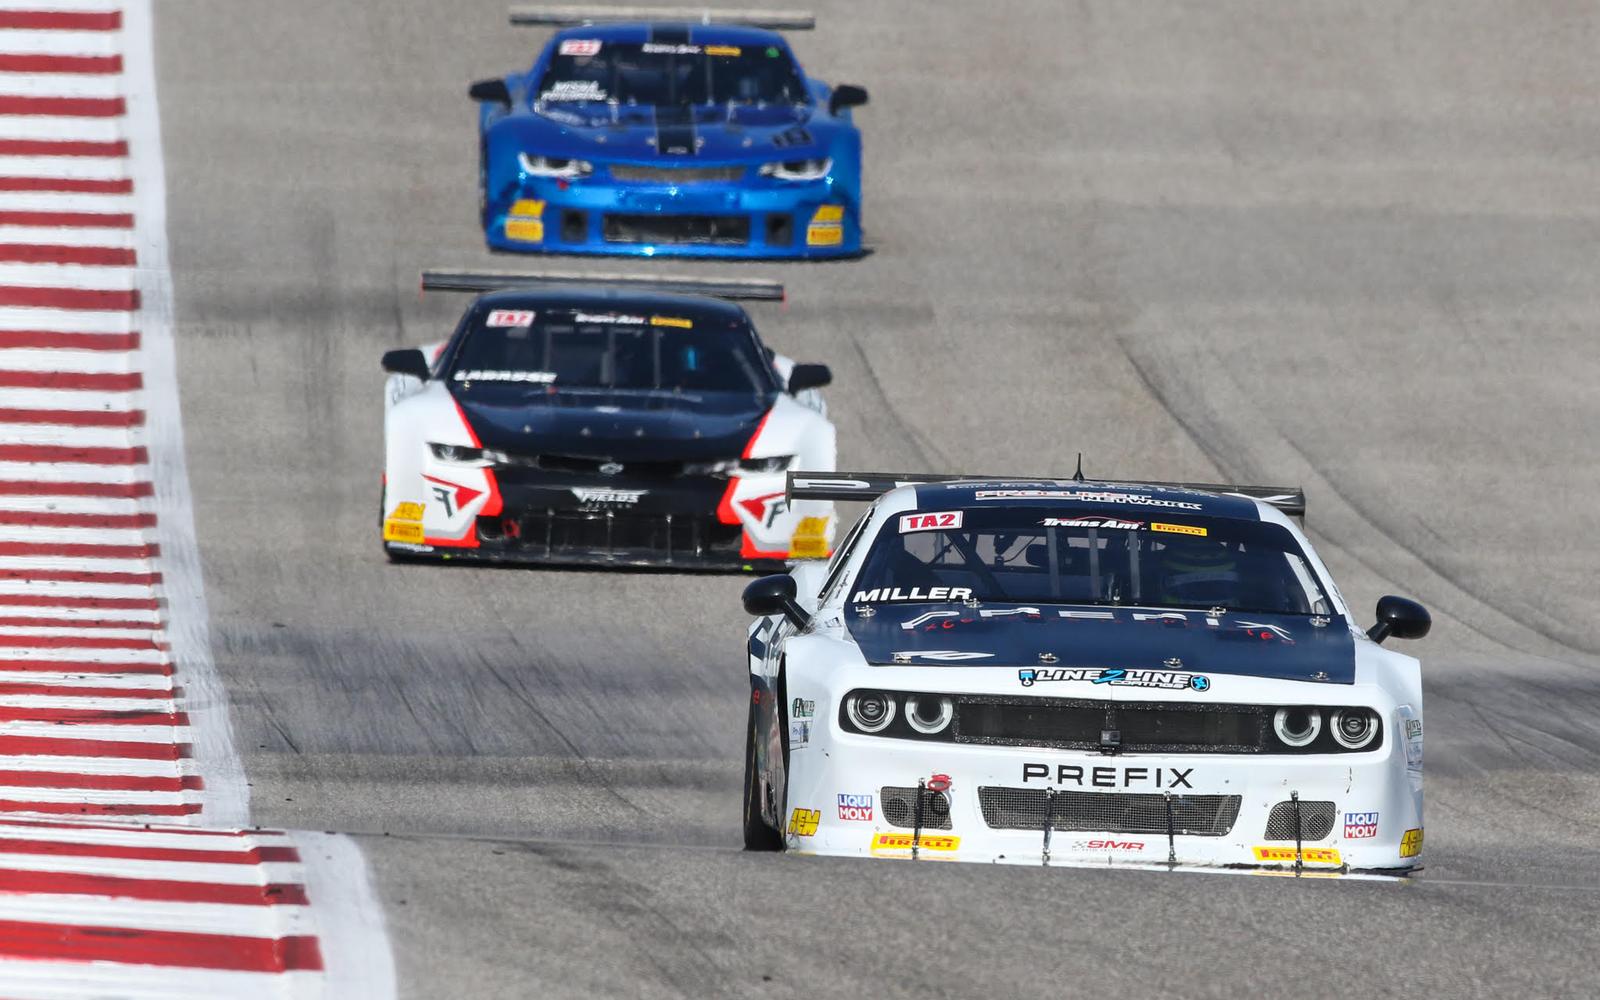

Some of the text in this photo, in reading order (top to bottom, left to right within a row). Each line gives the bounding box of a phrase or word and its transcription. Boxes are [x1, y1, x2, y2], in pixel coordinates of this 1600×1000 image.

[1081, 496, 1202, 511] NETWORK
[906, 513, 956, 529] TA2
[1043, 517, 1140, 530] Trans Am
[853, 587, 972, 603] MILLER
[1023, 763, 1194, 789] PREFIX
[839, 795, 872, 807] LIQUI
[840, 807, 872, 820] MOLY
[1345, 812, 1377, 825] LIQUI
[1345, 825, 1376, 837] MOLY
[1087, 840, 1145, 850] SMR
